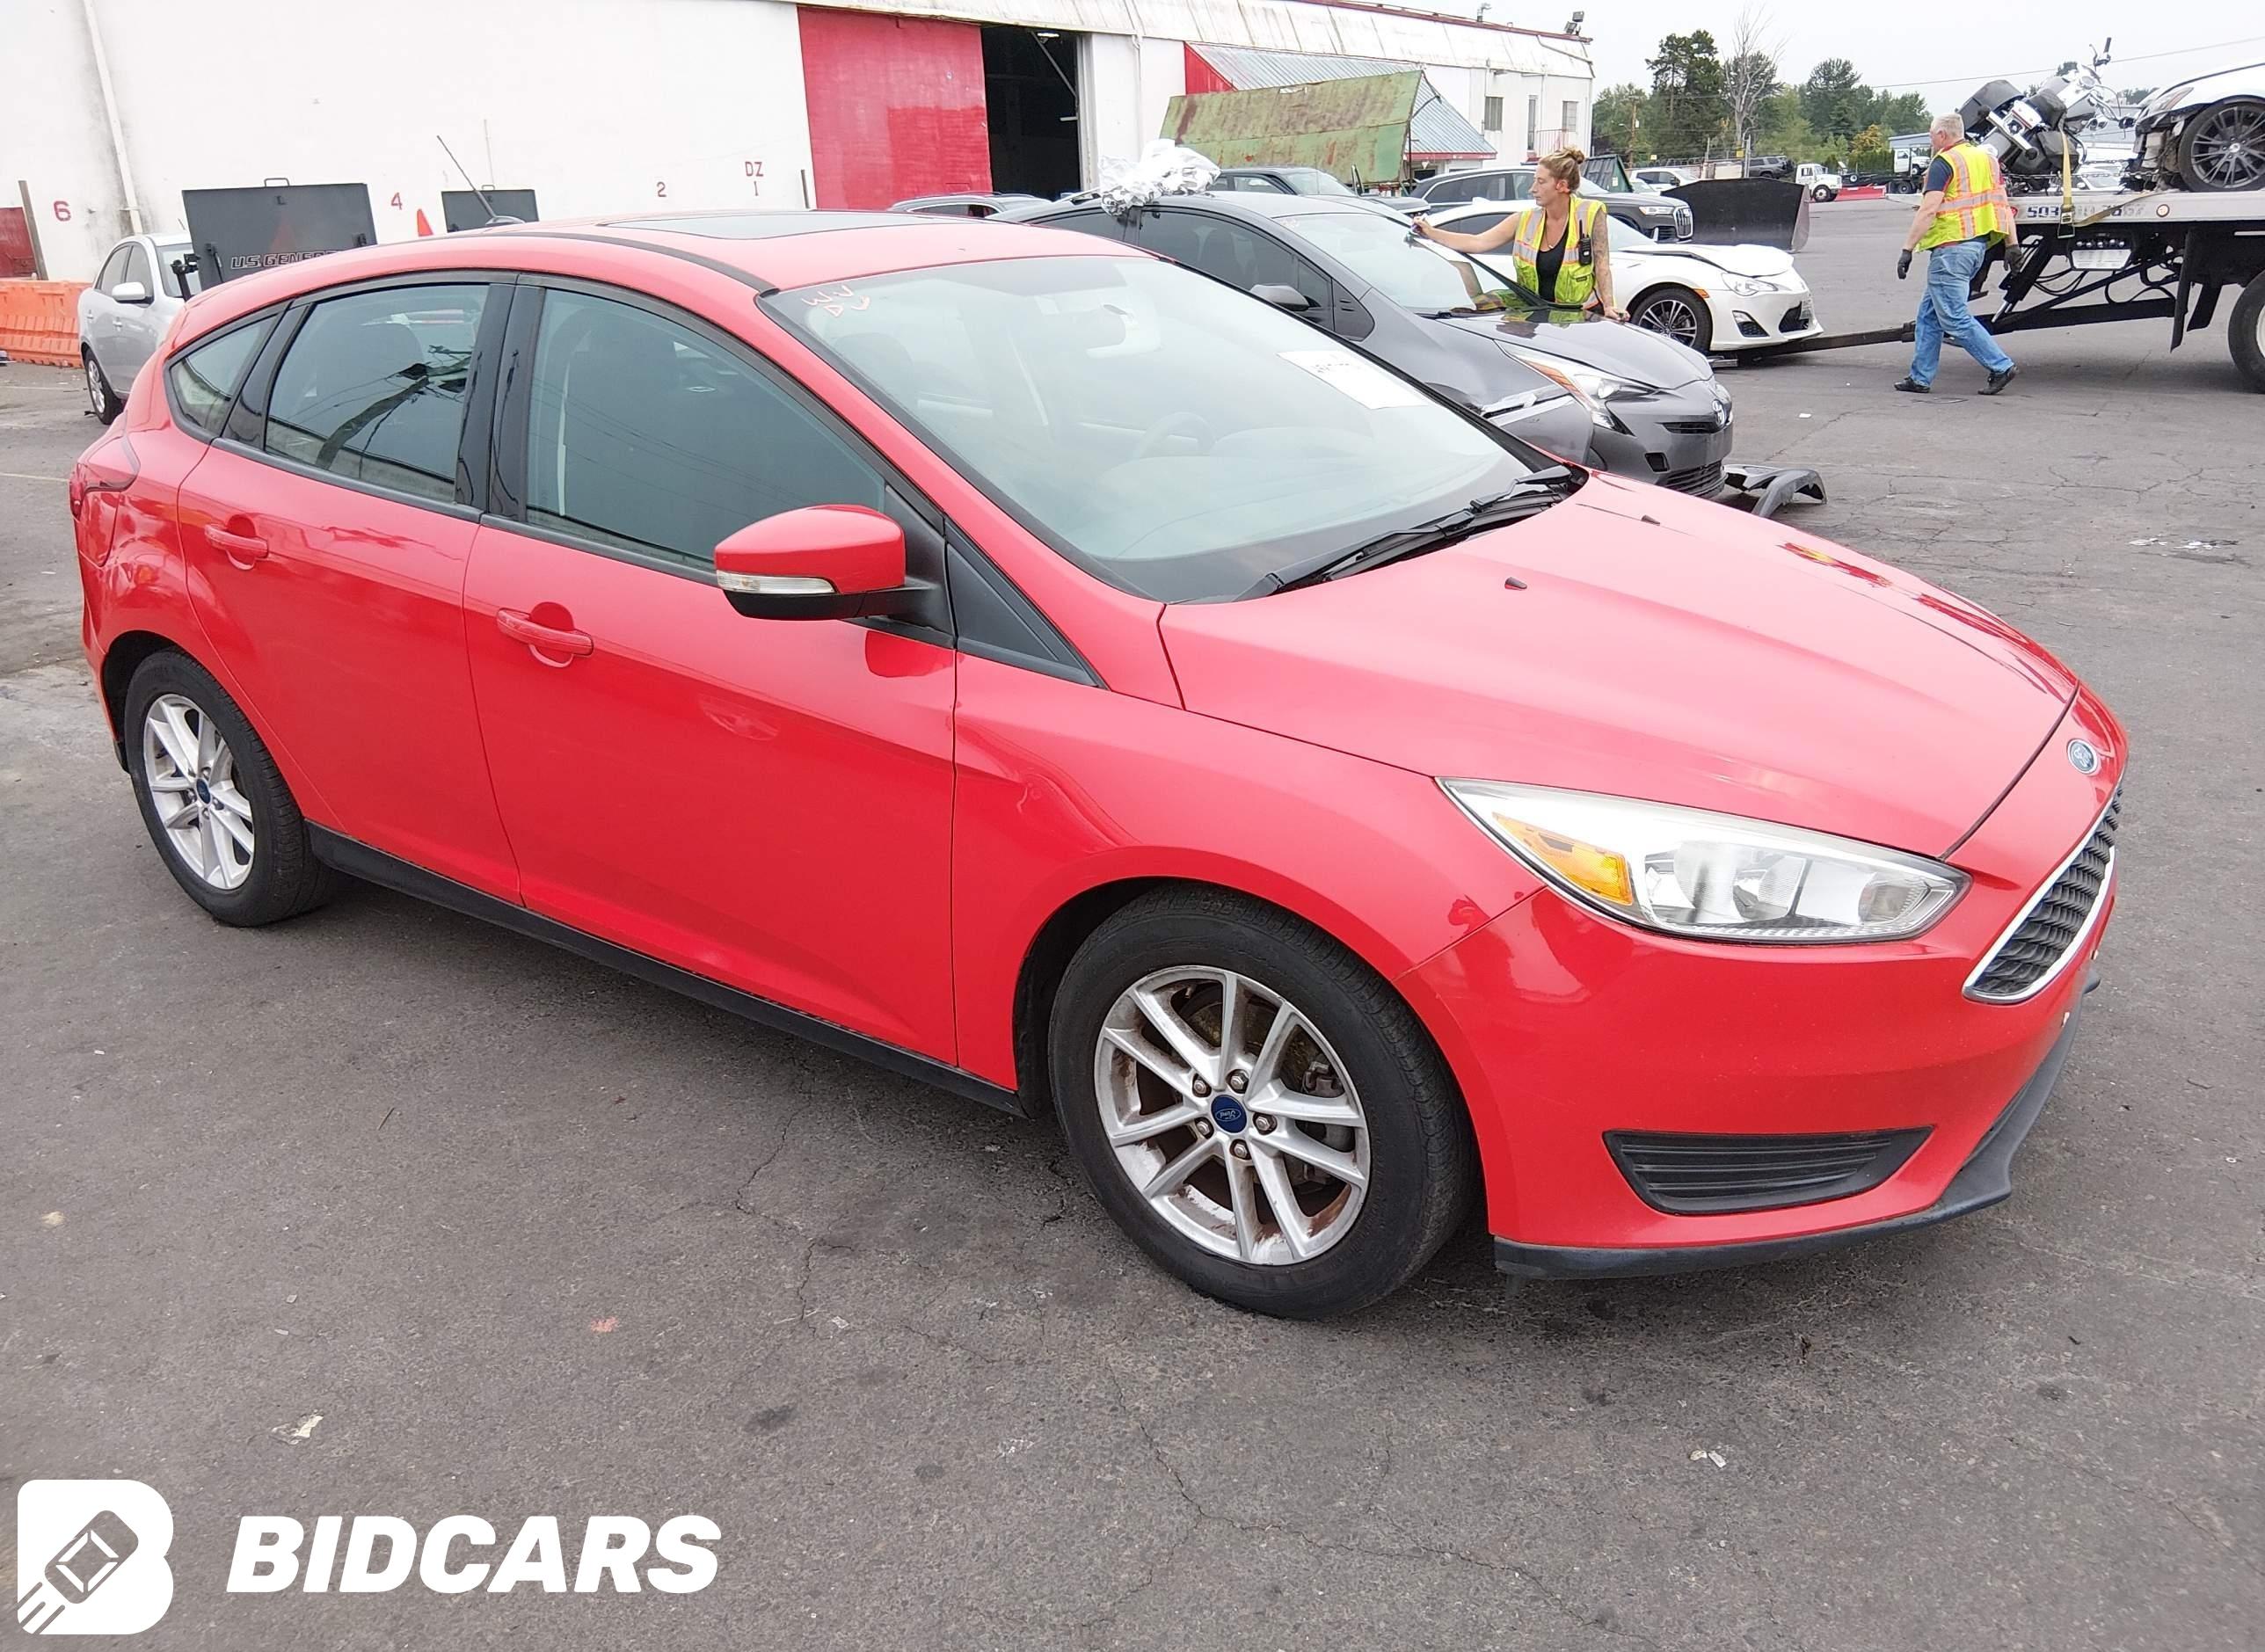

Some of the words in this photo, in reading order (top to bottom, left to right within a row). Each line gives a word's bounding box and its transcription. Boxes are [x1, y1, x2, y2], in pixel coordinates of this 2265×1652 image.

[745, 161, 764, 177] DZ
[657, 181, 666, 197] 2
[391, 193, 403, 210] 4
[54, 200, 71, 222] 6
